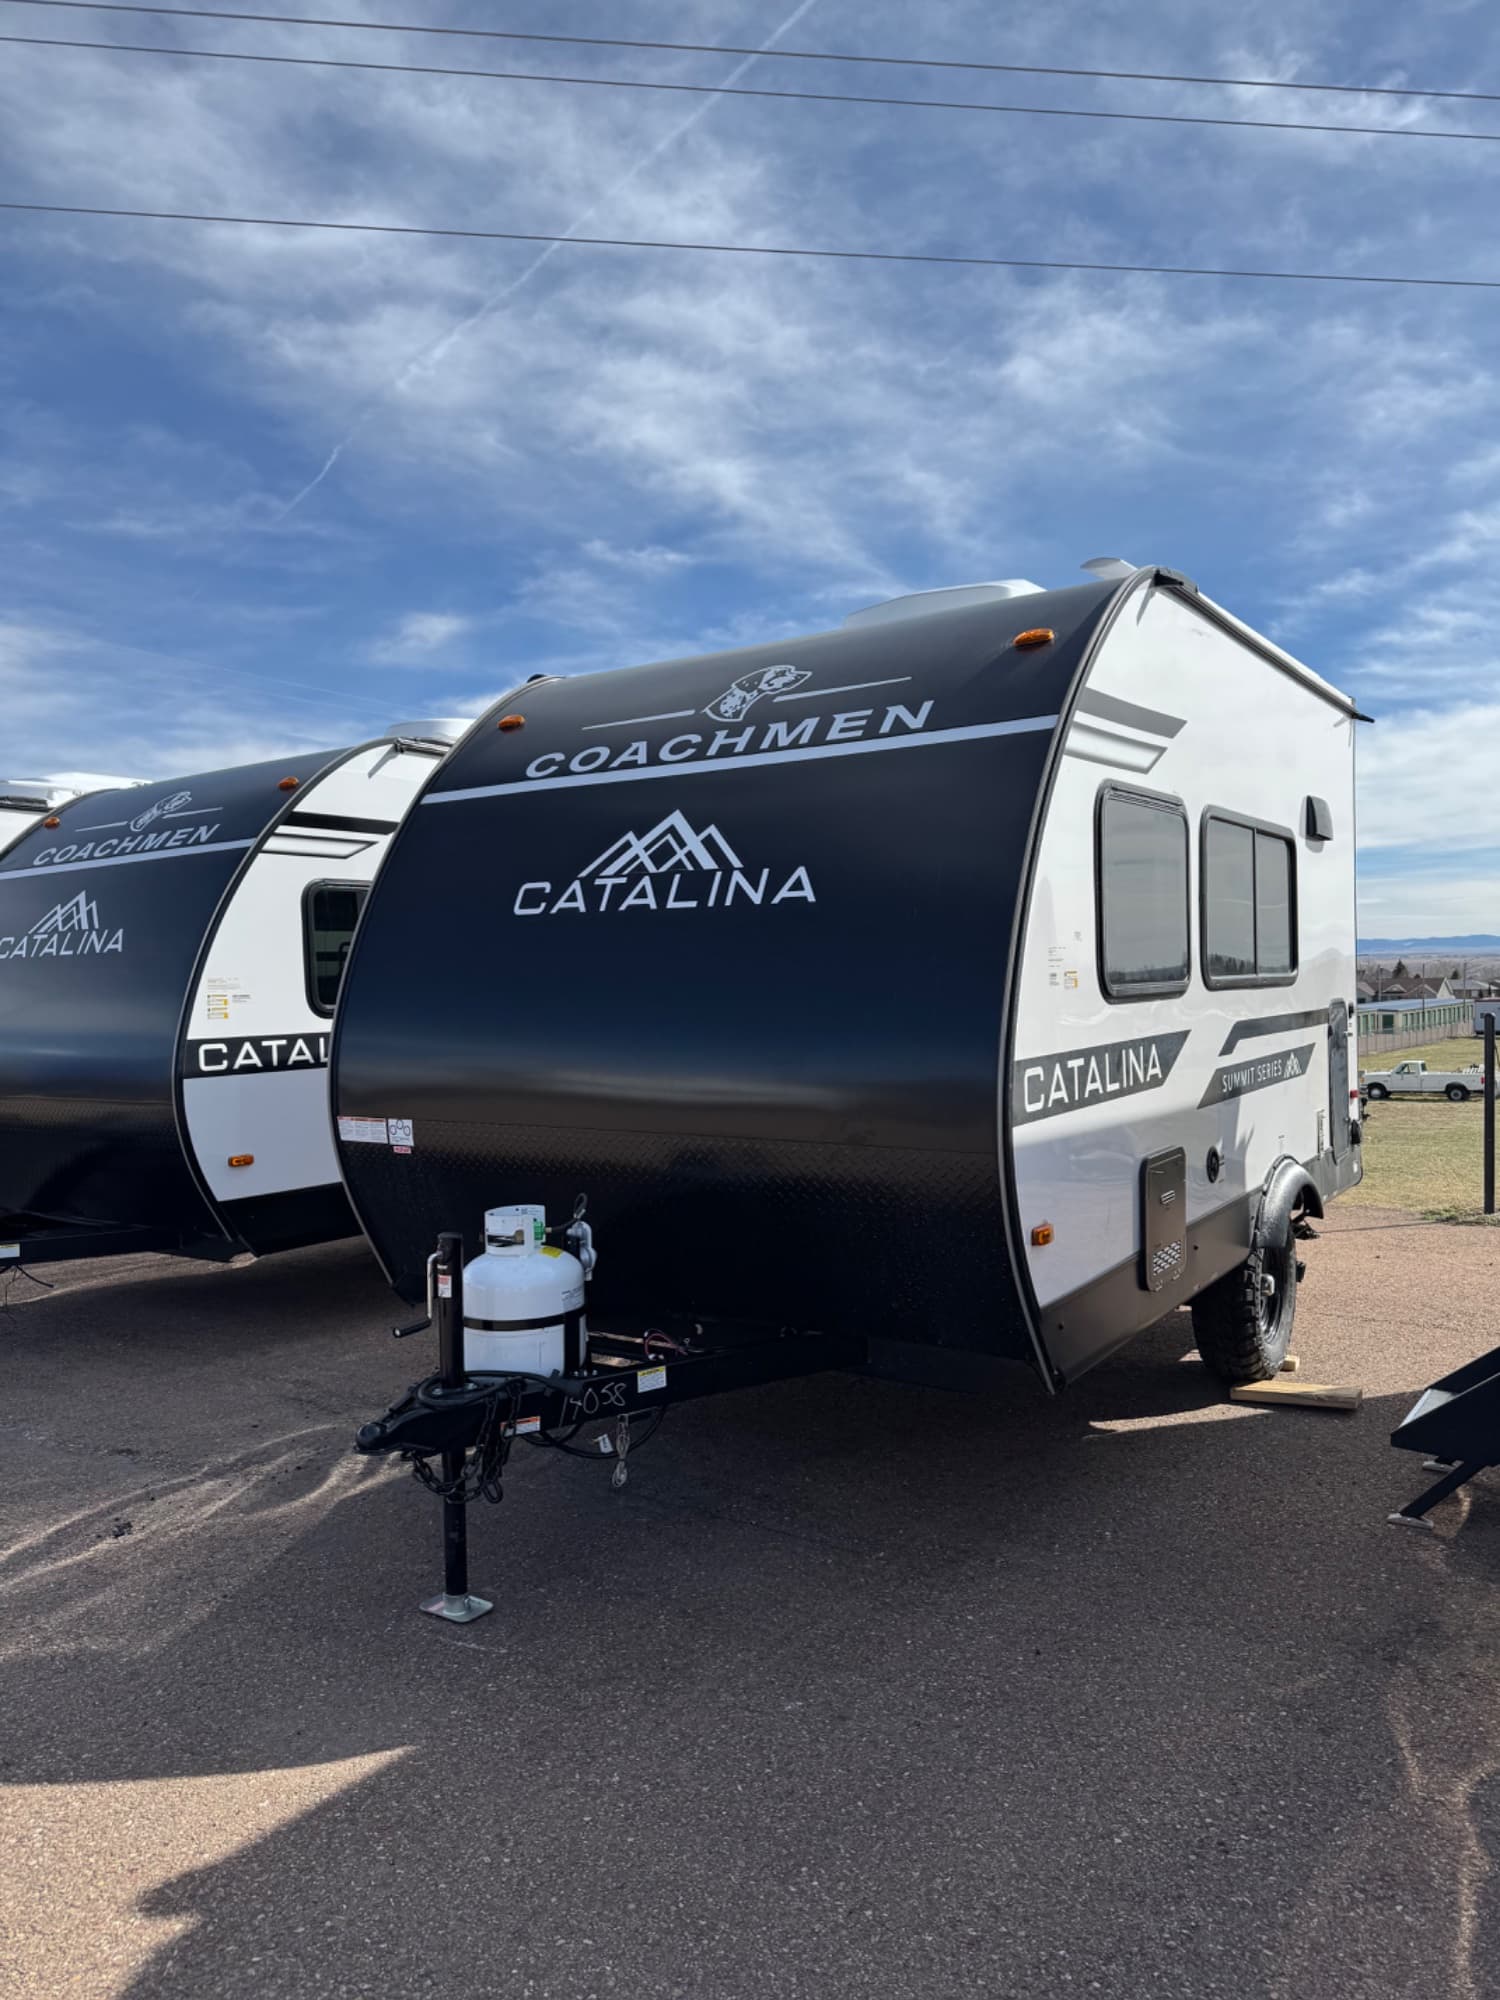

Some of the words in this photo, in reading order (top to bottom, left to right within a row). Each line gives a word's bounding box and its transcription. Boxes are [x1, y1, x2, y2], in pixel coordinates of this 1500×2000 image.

[525, 699, 935, 779] COACHMEN
[32, 823, 222, 867] COACHMEN
[513, 866, 817, 917] CATALINA
[0, 928, 124, 959] CATALINA
[1023, 1043, 1163, 1113] CATALINA
[1222, 1067, 1255, 1093] SUMMIT
[1257, 1059, 1282, 1083] SERIES
